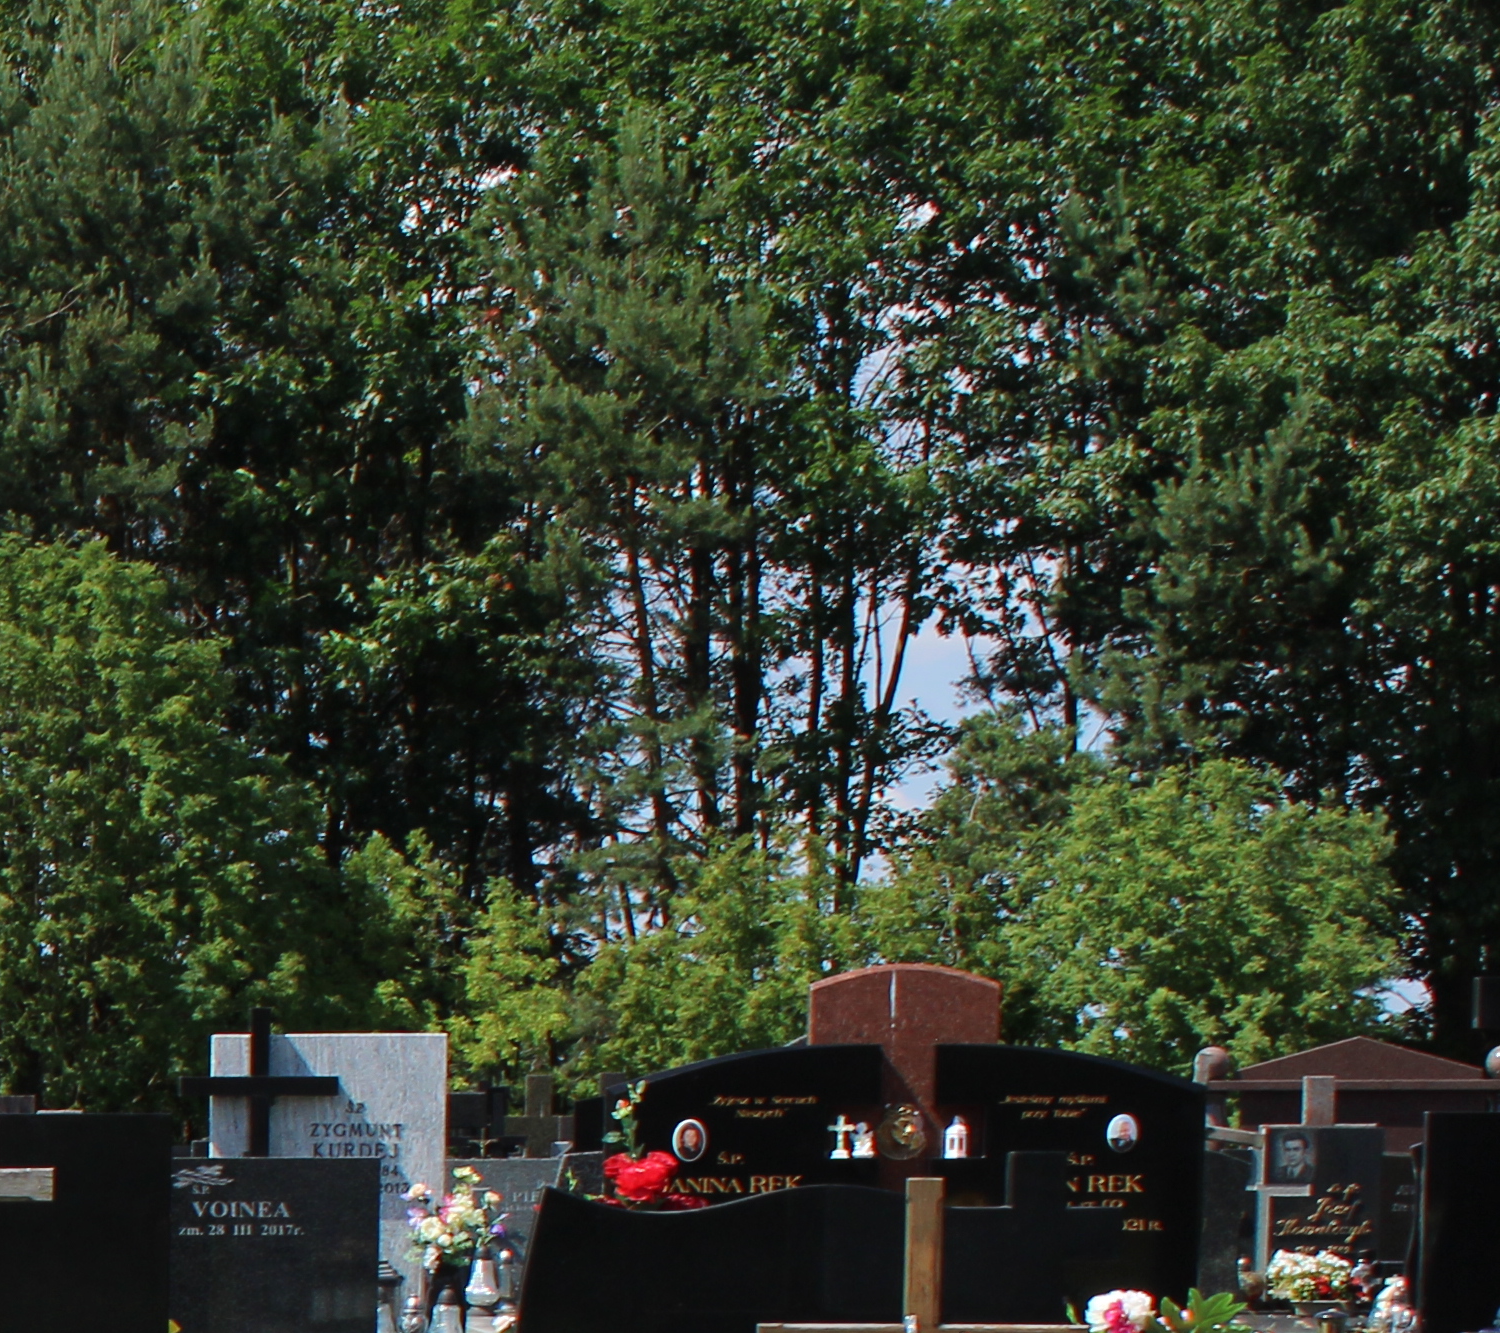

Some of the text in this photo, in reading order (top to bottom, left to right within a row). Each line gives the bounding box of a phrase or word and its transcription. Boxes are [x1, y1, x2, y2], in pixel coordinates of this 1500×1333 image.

[310, 1123, 403, 1138] ZYGMUNT
[313, 1142, 399, 1159] KURDEJ
[749, 1175, 803, 1193] REK
[1087, 1174, 1145, 1193] REK
[192, 1201, 290, 1218] VOINEA
